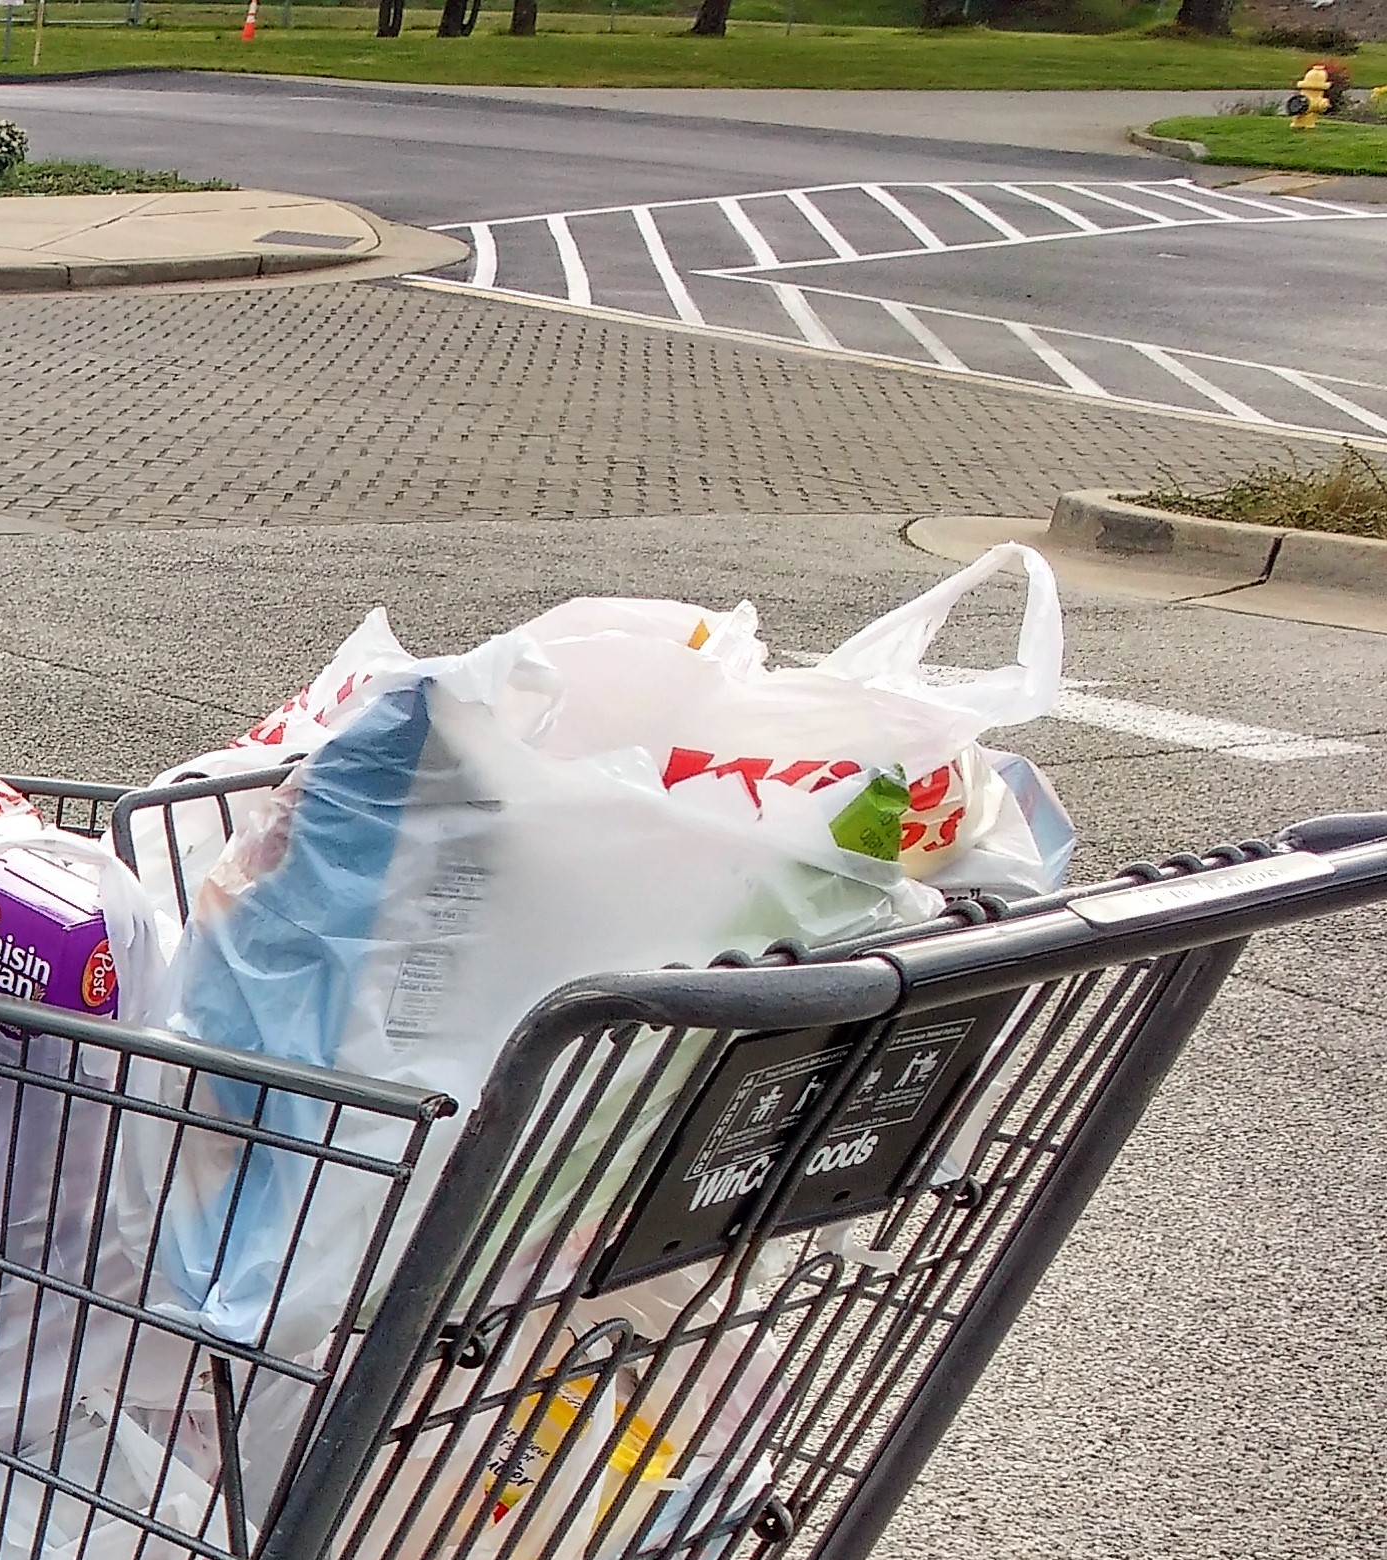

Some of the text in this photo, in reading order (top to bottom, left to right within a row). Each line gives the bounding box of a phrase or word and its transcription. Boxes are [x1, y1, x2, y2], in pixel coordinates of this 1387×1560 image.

[93, 950, 116, 998] Post
[689, 1155, 776, 1212] WinC
[806, 1130, 879, 1176] oods
